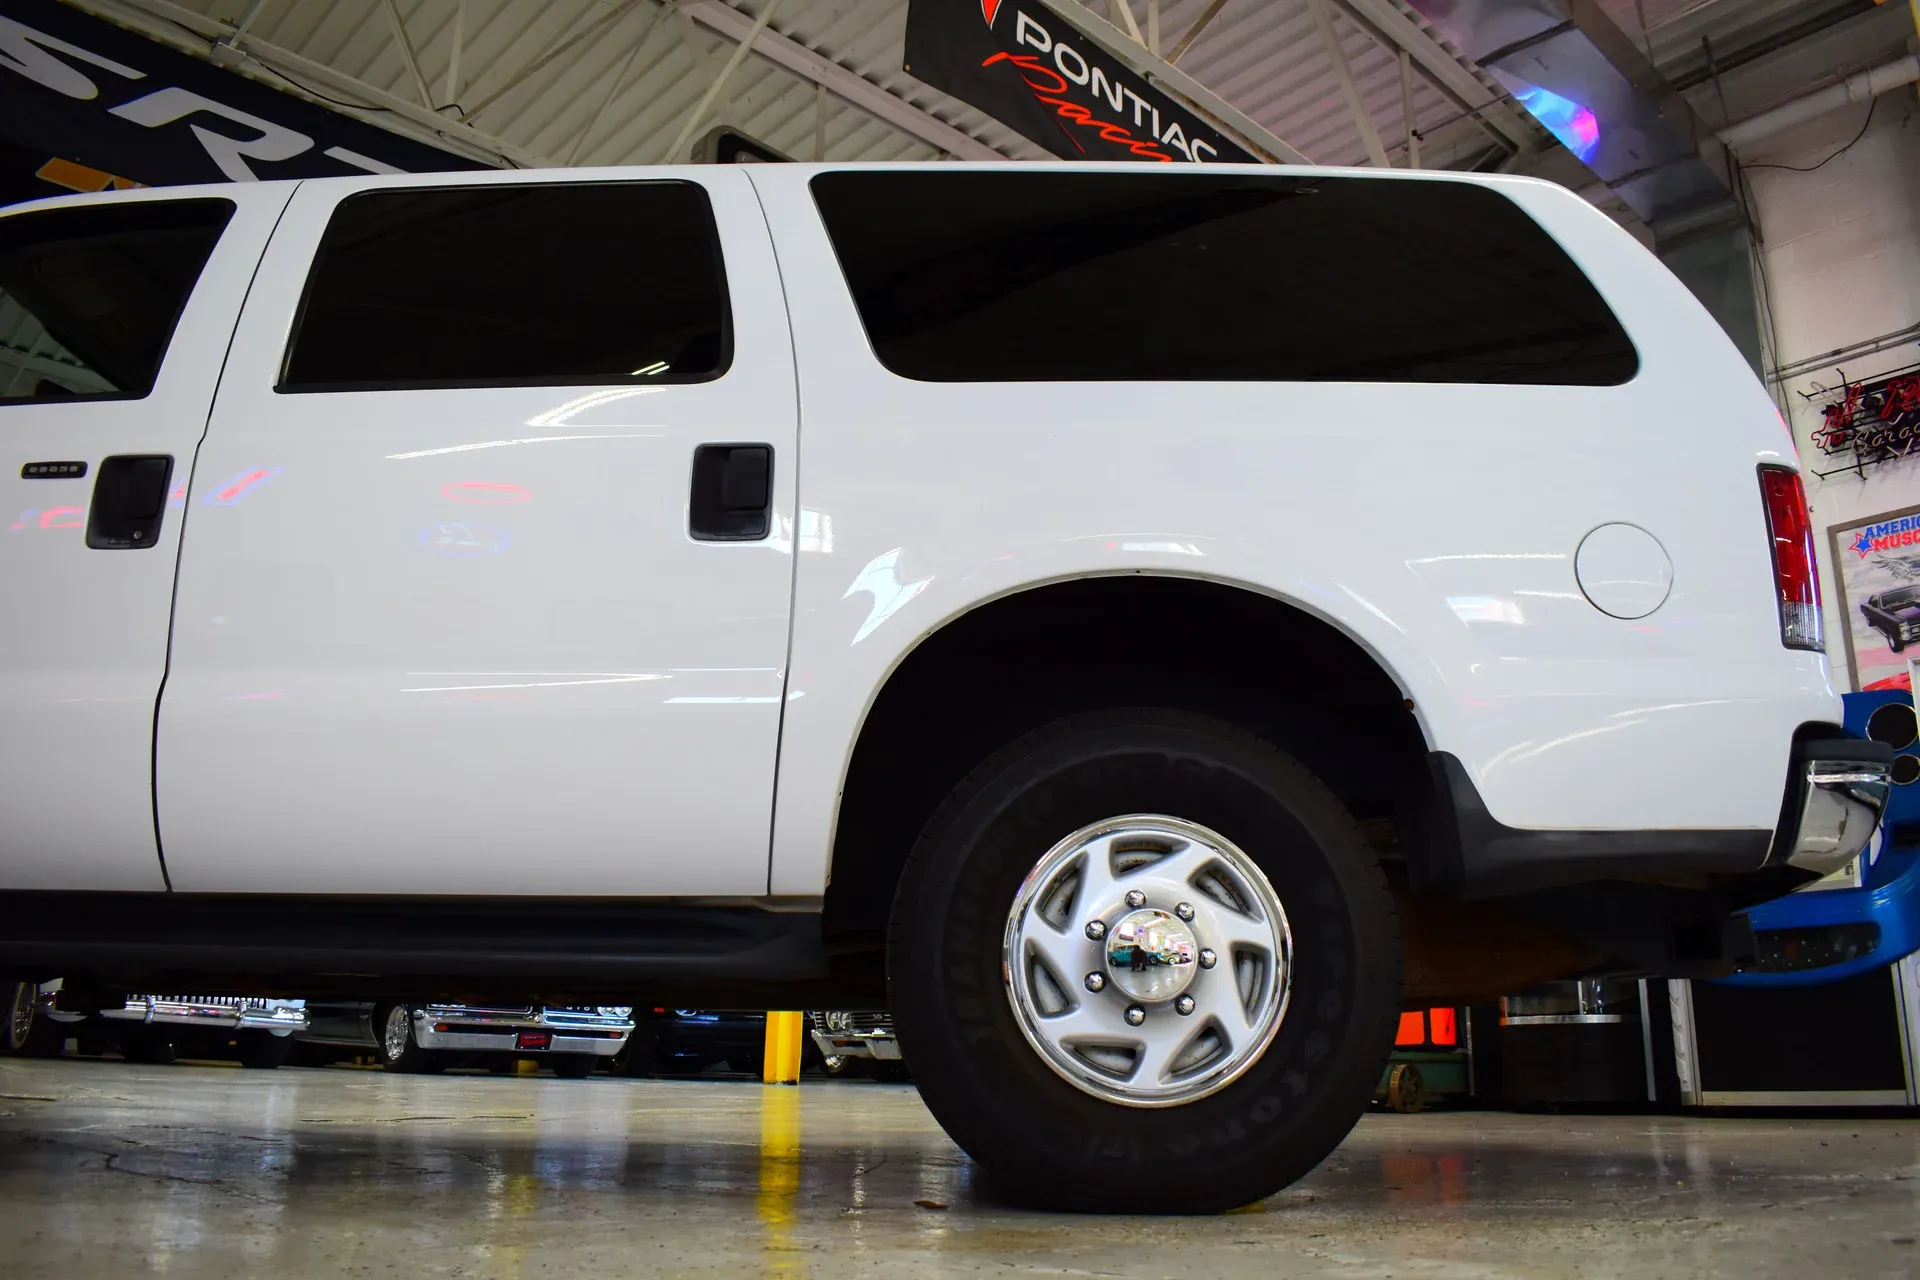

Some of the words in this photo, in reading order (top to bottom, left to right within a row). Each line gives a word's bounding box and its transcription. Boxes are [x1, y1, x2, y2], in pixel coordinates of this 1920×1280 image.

[0, 15, 411, 182] SR
[982, 52, 1173, 162] Raci
[1017, 10, 1218, 163] PONTIAC
